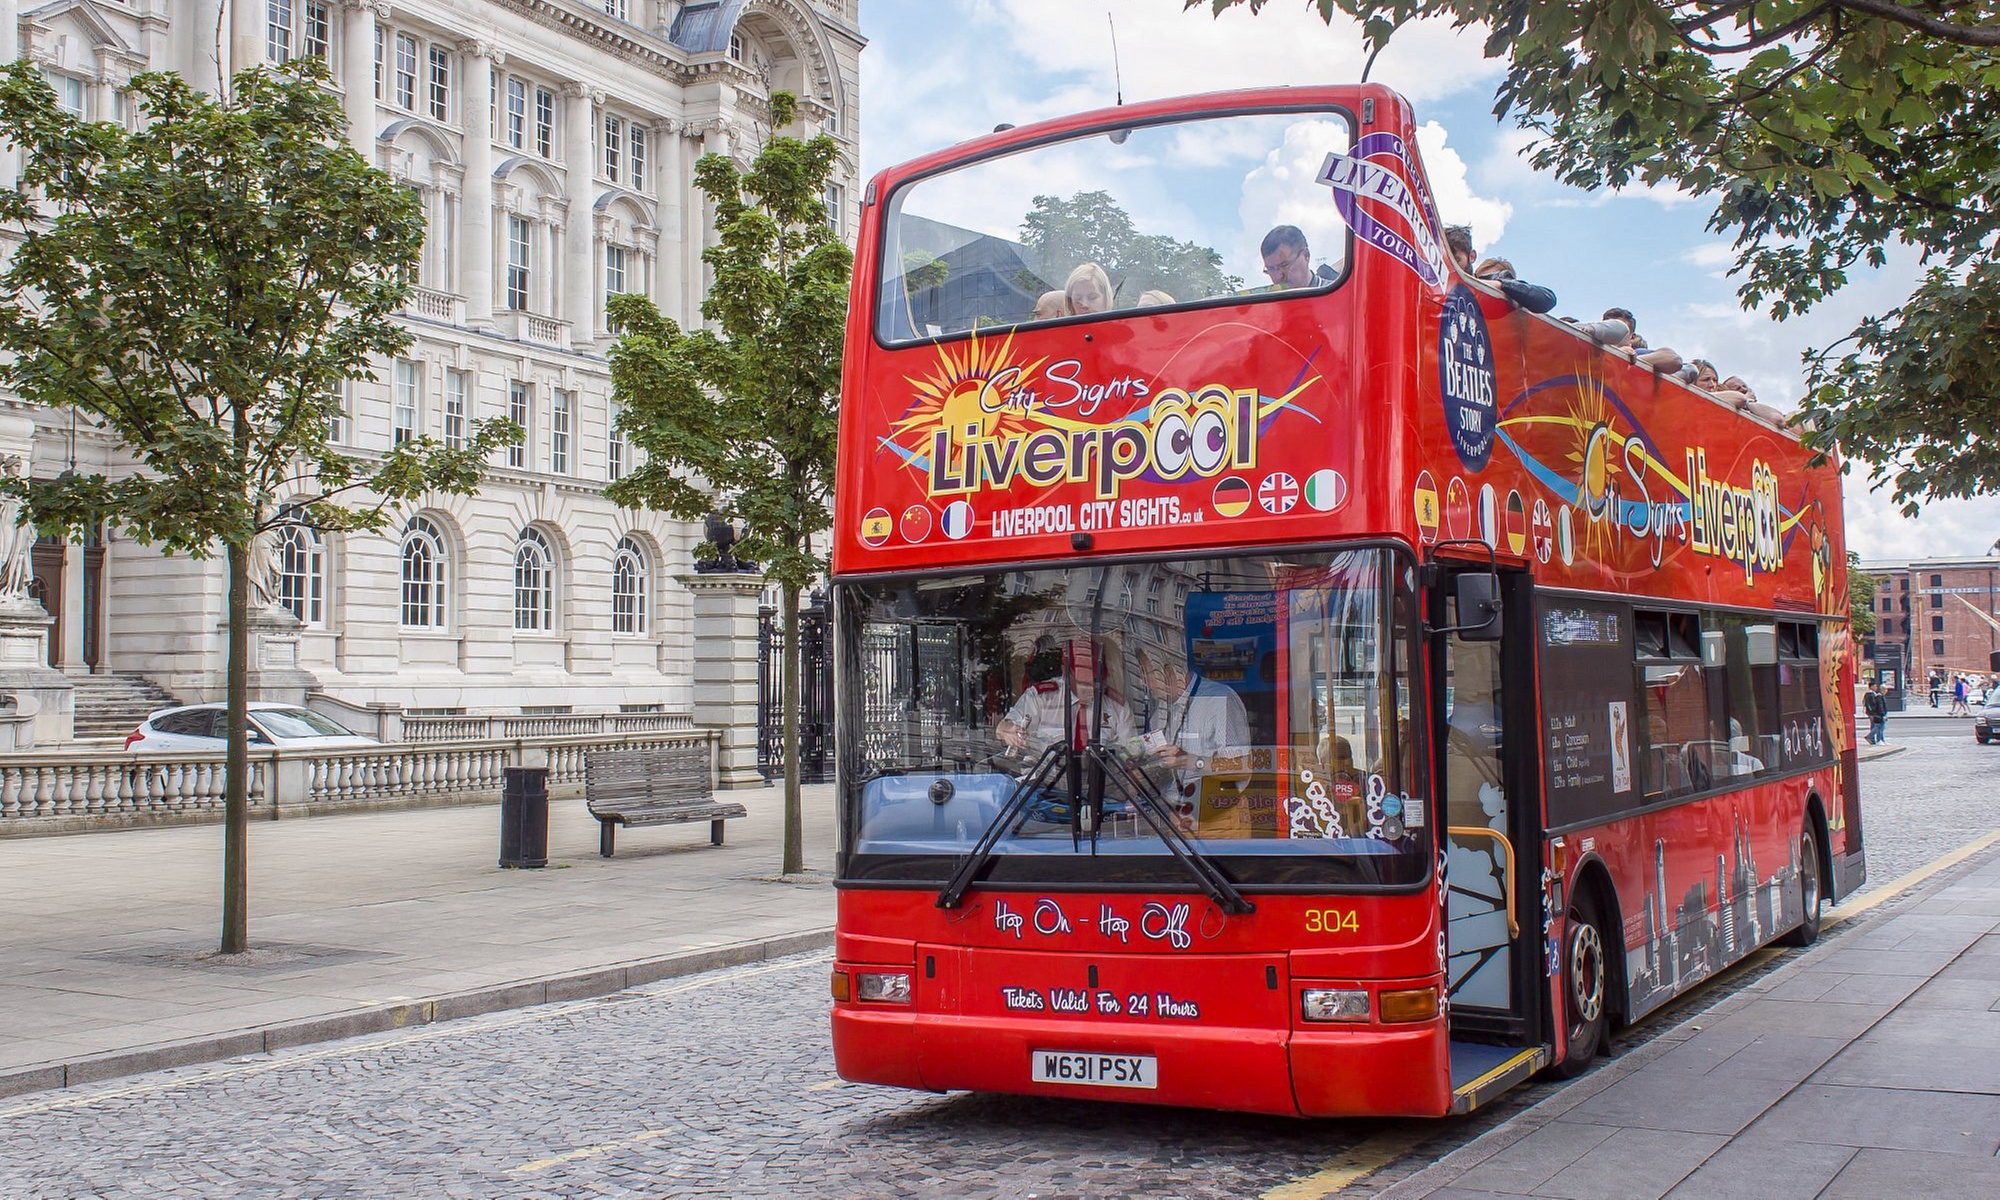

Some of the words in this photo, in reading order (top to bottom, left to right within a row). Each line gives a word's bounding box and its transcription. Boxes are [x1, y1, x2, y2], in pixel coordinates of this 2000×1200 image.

[1325, 157, 1446, 285] LIVERPOOL
[1372, 226, 1414, 264] TOUR
[1462, 342, 1473, 361] THE
[980, 366, 1035, 419] City
[1044, 360, 1150, 416] Sights
[1444, 338, 1493, 407] BEATLES
[1460, 406, 1482, 434] STORY
[929, 385, 1258, 500] Liverpool
[992, 504, 1076, 538] LIVERPOOL
[1080, 501, 1116, 531] CITY
[1624, 434, 1687, 569] Sights
[1686, 447, 1784, 587] Liverpool
[1335, 784, 1354, 793] PRS
[995, 900, 1024, 939] Hop
[1033, 899, 1072, 935] On
[1099, 904, 1130, 943] Hop
[1141, 903, 1192, 949] Off
[1305, 909, 1360, 934] 304
[1003, 988, 1044, 1010] Tickets
[1051, 990, 1089, 1011] Valid
[1097, 992, 1121, 1013] For
[1129, 995, 1148, 1015] 24
[1157, 995, 1198, 1017] Hours
[1045, 1054, 1094, 1080] W631
[1099, 1056, 1143, 1082] PSX
